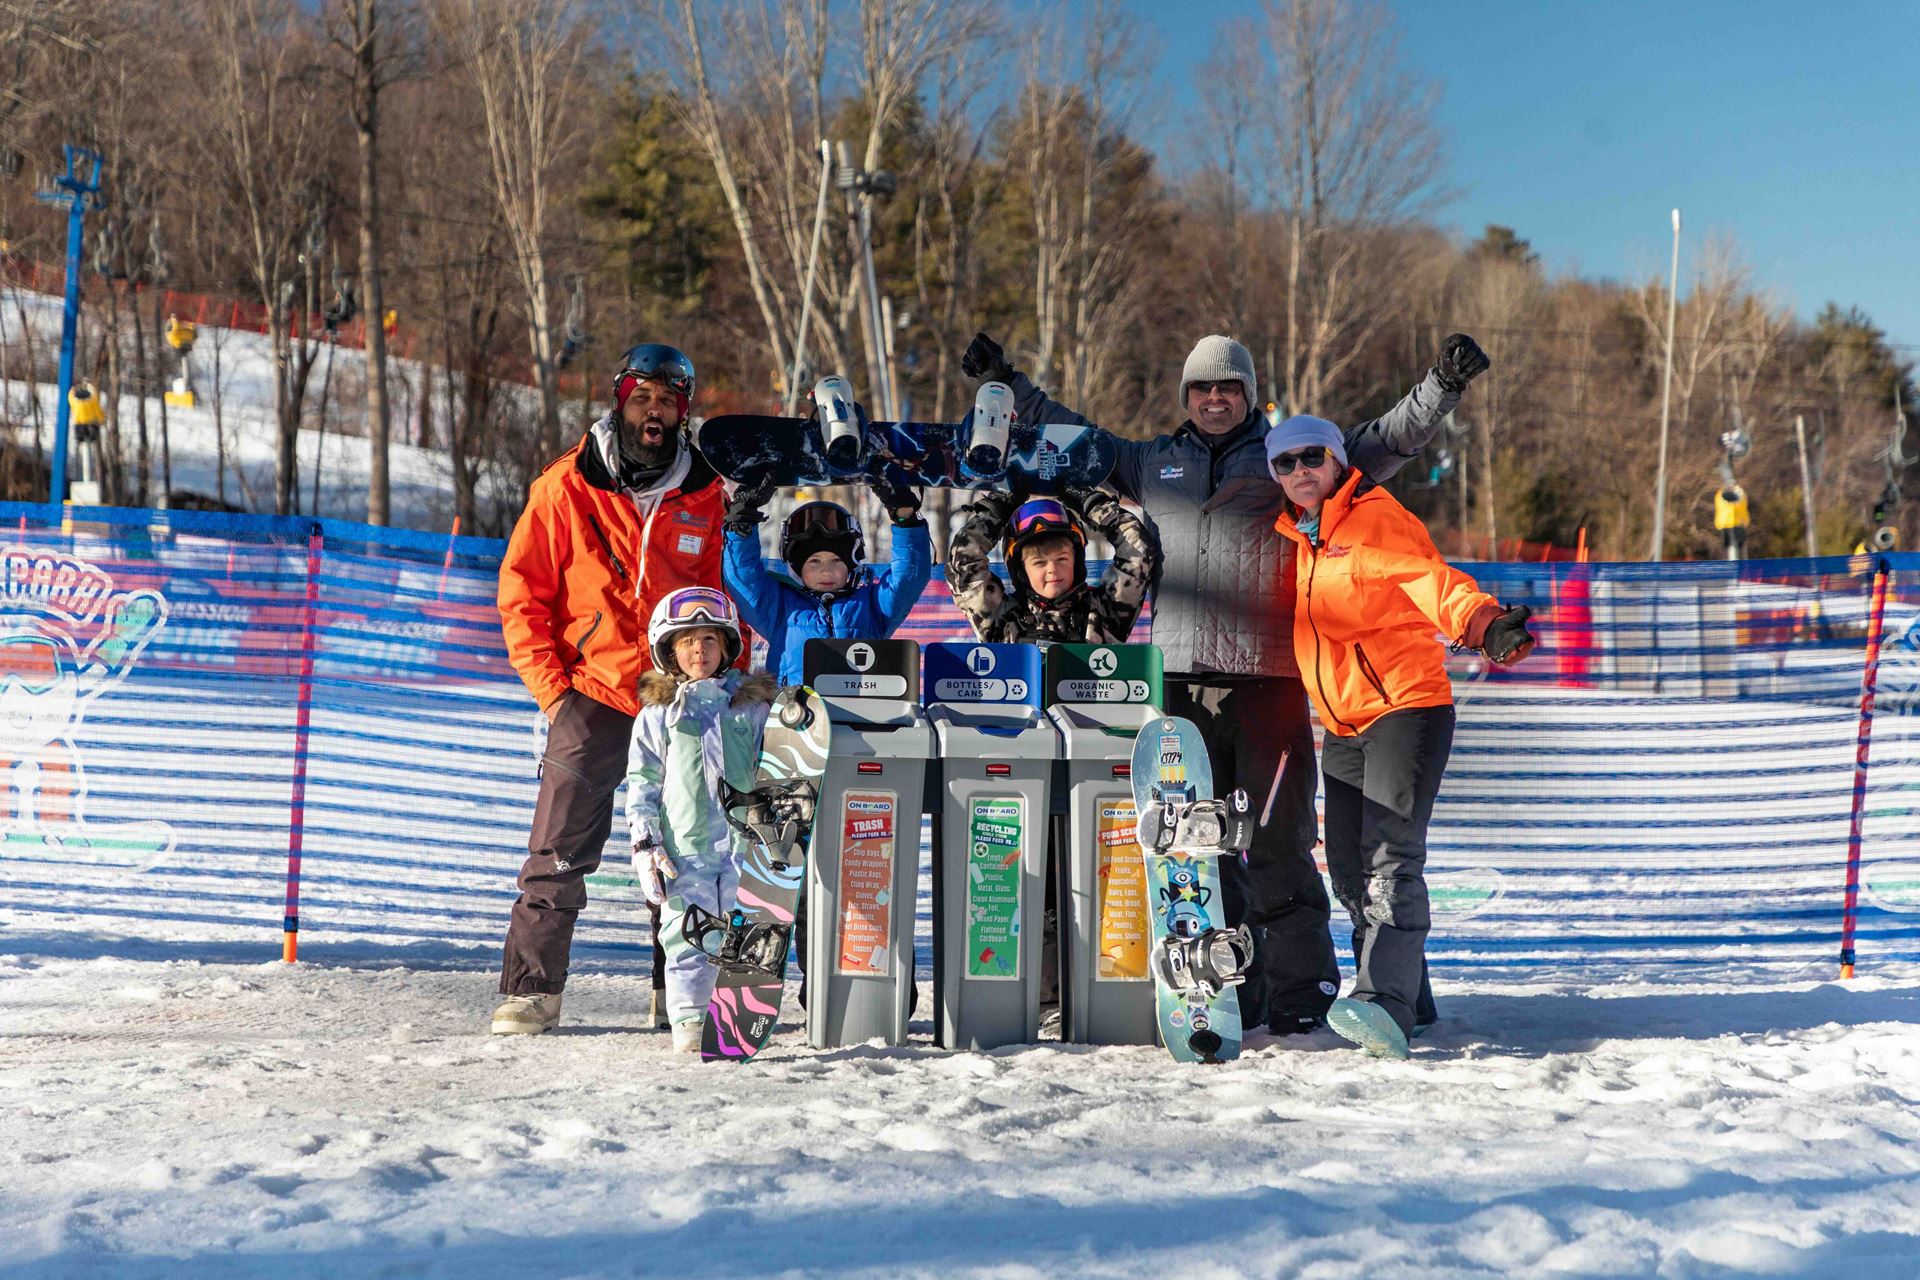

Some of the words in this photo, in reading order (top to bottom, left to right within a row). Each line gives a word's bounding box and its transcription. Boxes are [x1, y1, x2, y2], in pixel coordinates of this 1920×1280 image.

[1036, 440, 1050, 480] BURTON
[844, 681, 877, 689] TRASH
[946, 681, 995, 690] BOTTLES/
[1070, 682, 1115, 690] ORGANIC
[853, 819, 884, 832] TRASH
[976, 822, 1017, 836] RECYCLING
[1102, 831, 1119, 840] FOOD
[987, 854, 1003, 862] Empty
[845, 859, 861, 867] Candy
[851, 881, 864, 889] Cling
